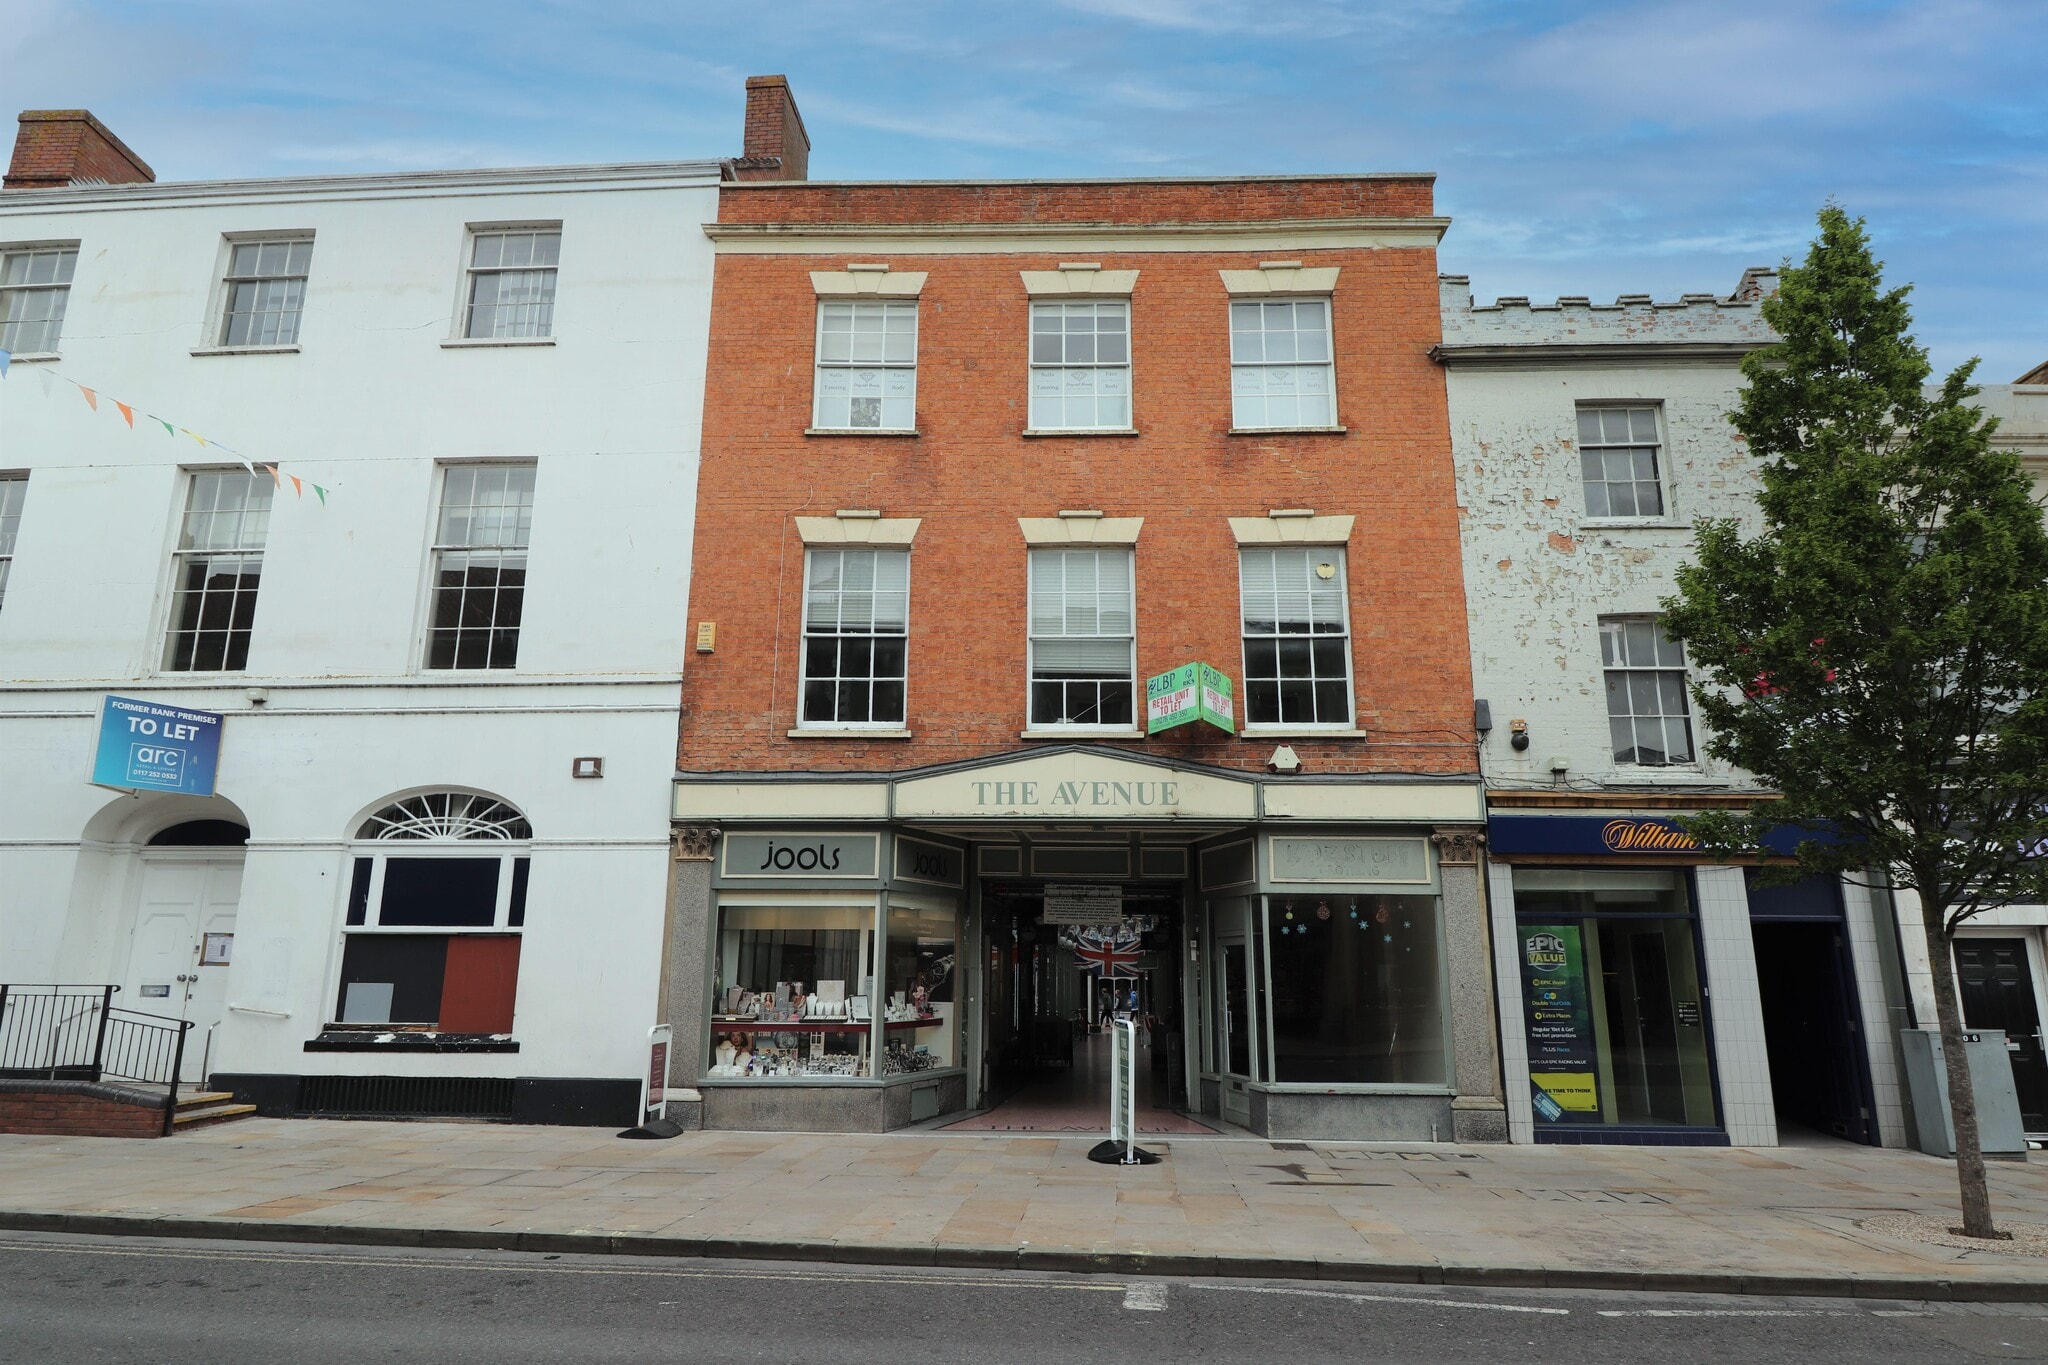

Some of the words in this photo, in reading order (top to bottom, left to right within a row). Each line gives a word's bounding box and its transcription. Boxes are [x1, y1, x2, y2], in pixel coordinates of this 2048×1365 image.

[1156, 672, 1176, 692] LBP
[1152, 695, 1173, 709] RETAIL
[1174, 689, 1189, 700] UNIT
[1160, 706, 1168, 716] TO
[1170, 700, 1182, 712] LET
[112, 701, 150, 714] FORMER
[151, 707, 176, 718] BANK
[177, 712, 217, 725] PREMISES
[127, 716, 158, 735] TO
[163, 722, 199, 741] LET
[138, 748, 178, 766] arc
[972, 782, 1040, 806] THE
[1050, 781, 1180, 806] AVENUE
[1602, 819, 1700, 850] William
[760, 841, 840, 870] jools
[913, 847, 948, 878] jools
[1526, 936, 1565, 952] EPIC
[1528, 953, 1565, 963] VALUE
